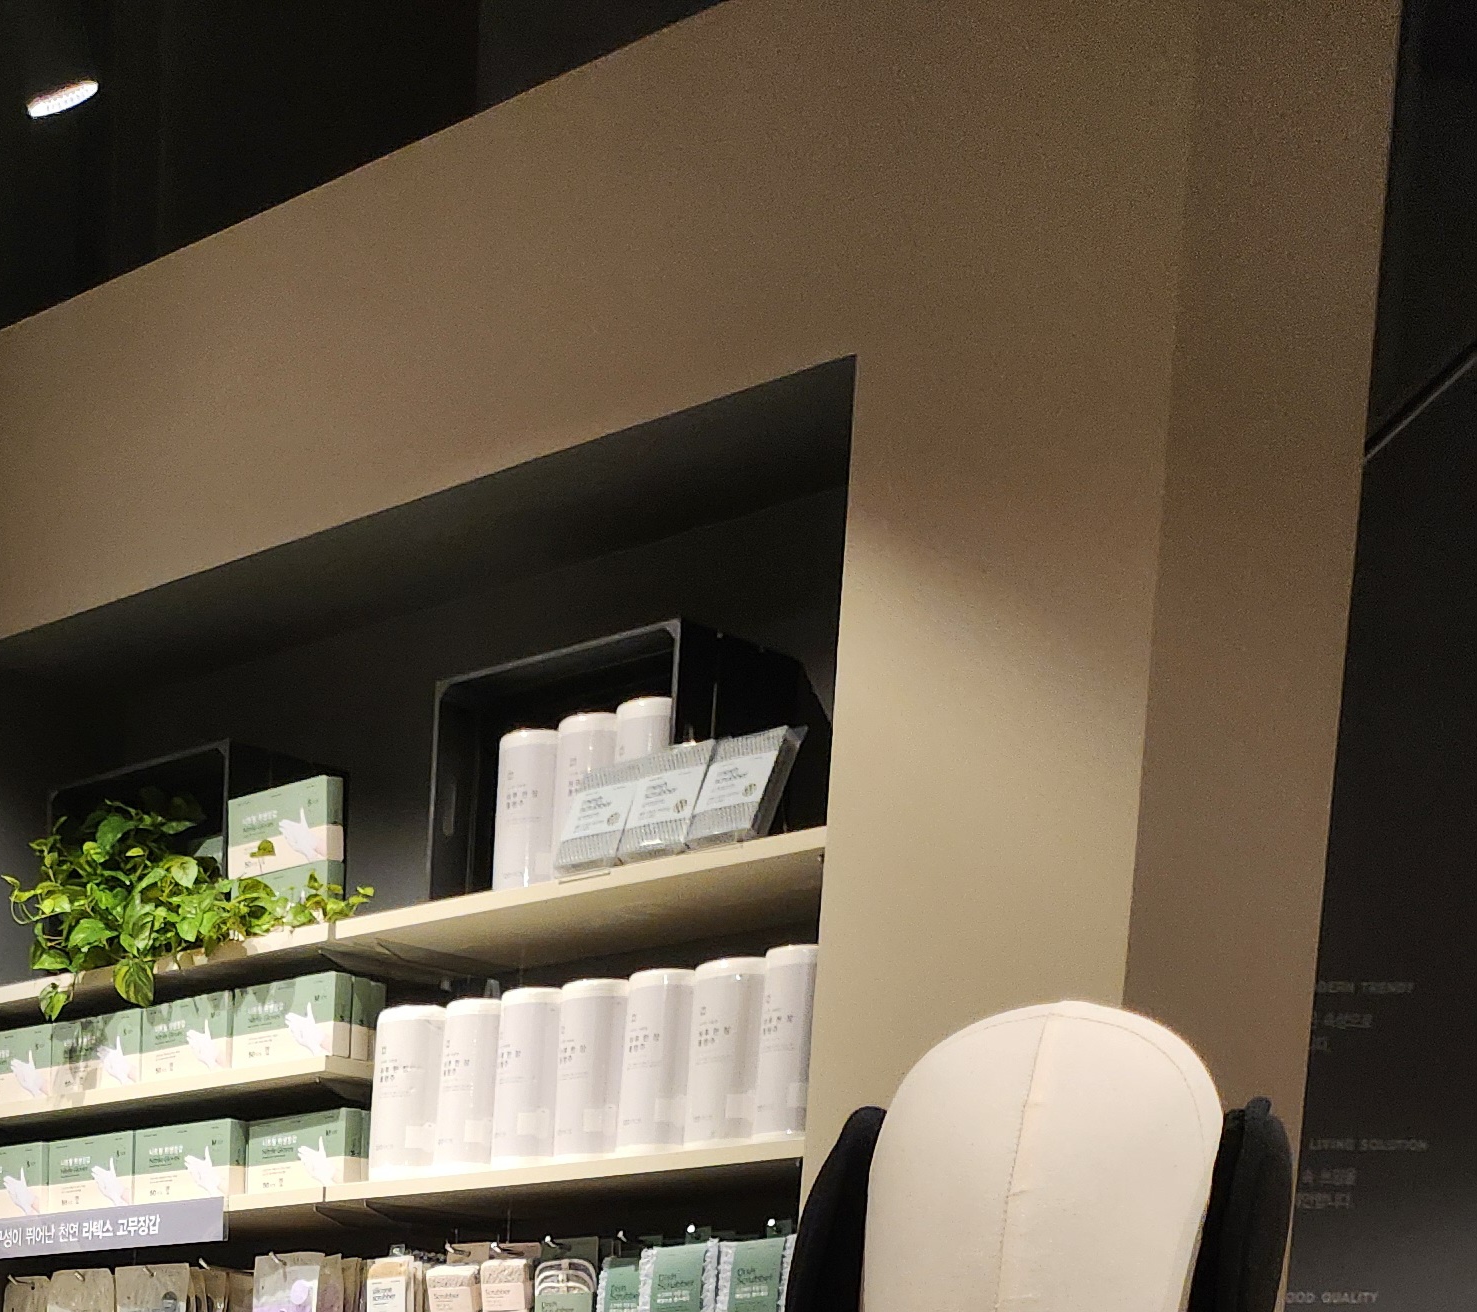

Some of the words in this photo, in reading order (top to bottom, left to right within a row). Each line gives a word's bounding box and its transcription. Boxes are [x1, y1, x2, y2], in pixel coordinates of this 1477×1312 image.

[26, 1222, 55, 1246] 뛰어난
[59, 1221, 79, 1242] 천연
[82, 1218, 114, 1240] 라텍스
[117, 1214, 161, 1236] 고무장갑
[1284, 1291, 1315, 1304] OOD
